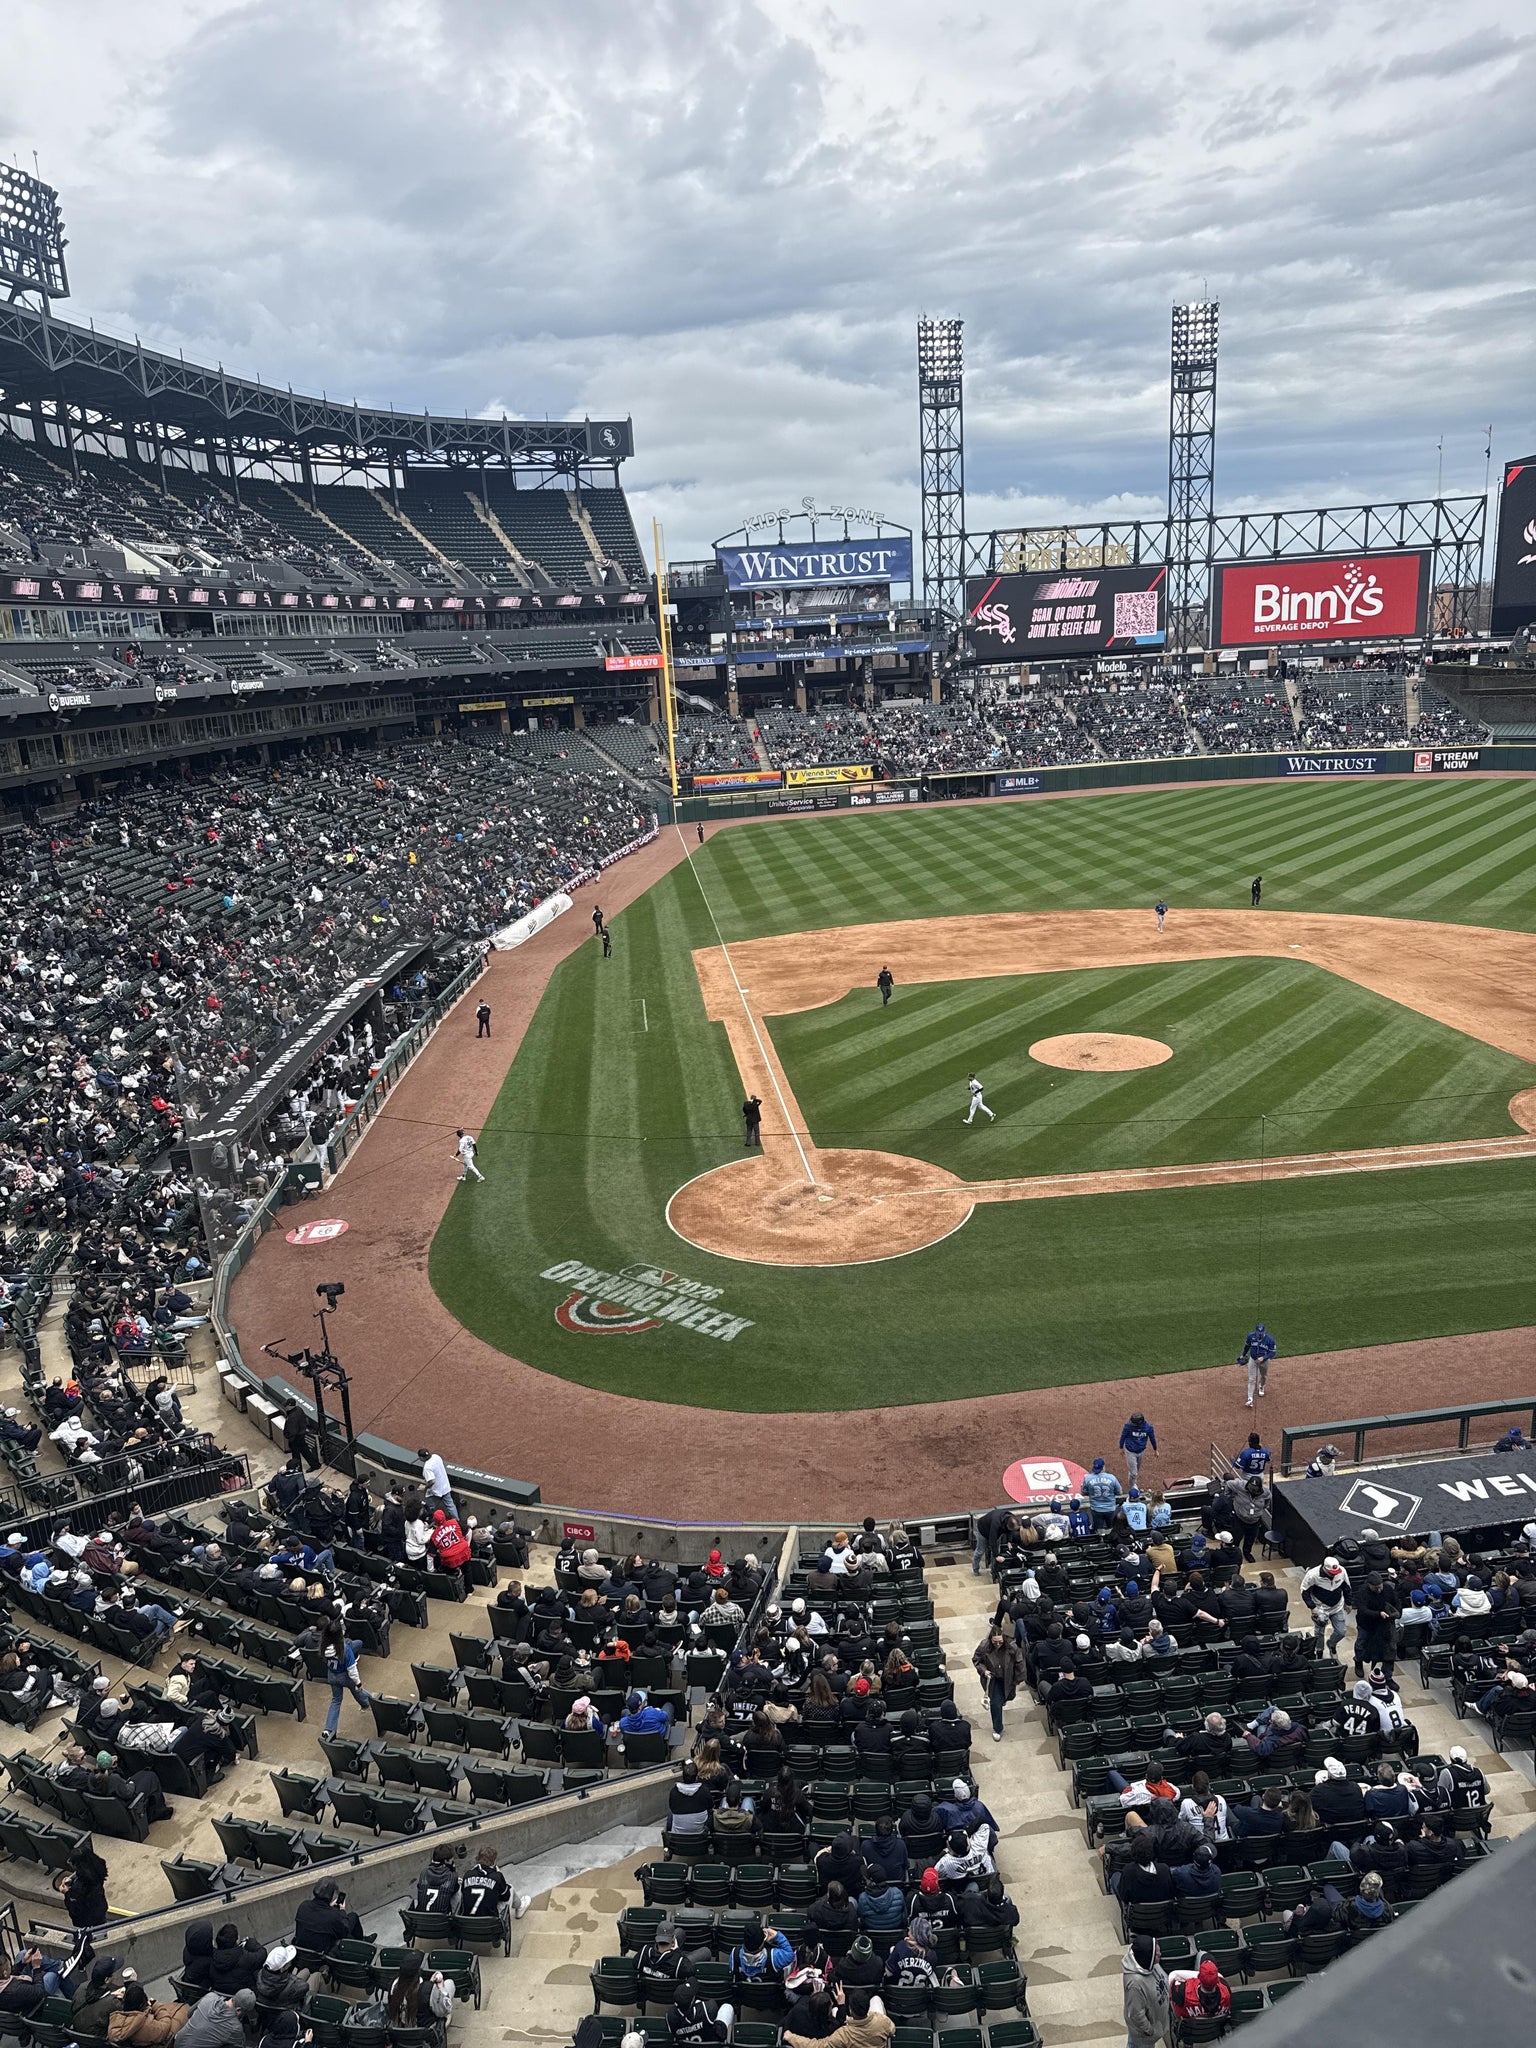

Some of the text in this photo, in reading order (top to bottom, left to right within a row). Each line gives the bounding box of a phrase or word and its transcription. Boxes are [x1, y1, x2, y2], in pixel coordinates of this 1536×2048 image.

[743, 507, 792, 533] KIDS
[830, 505, 886, 528] ZONE
[1001, 530, 1078, 547] CAESARS
[1001, 545, 1129, 573] SPORTSBOOK
[1032, 605, 1097, 622] SCAN QR CODE TO
[1028, 620, 1102, 639] JOIN THE SELFIE CAM
[1254, 621, 1331, 633] BEVERAGE DEPOT
[776, 650, 825, 660] Hometown Banking
[844, 646, 899, 656] Big-League Capabilities
[680, 657, 715, 665] WINTRUST
[1097, 660, 1127, 673] Modelo
[164, 688, 178, 698] FISK
[50, 694, 91, 707] 56 BUEHRLE
[1434, 751, 1479, 762] STREAM
[1287, 757, 1377, 771] WINTRUST
[1443, 760, 1469, 770] NOW
[801, 767, 841, 778] Vienna Beef
[1015, 777, 1040, 787] MLB+
[850, 794, 871, 806] Rate
[787, 804, 815, 812] Companies
[260, 1048, 301, 1079] CHICAGO
[217, 1105, 247, 1123] SOX
[666, 1276, 725, 1302] 2026
[539, 1259, 757, 1342] OPENING WEEK
[1249, 1459, 1265, 1470] 51
[1093, 1485, 1111, 1497] 32
[1026, 1493, 1085, 1504] TOYOTA
[1132, 1512, 1141, 1525] 4
[566, 1527, 584, 1536] CIBC
[1075, 1525, 1086, 1535] 11
[440, 1530, 461, 1548] 64
[561, 1559, 571, 1572] 12
[900, 1558, 912, 1570] 12
[1343, 1704, 1372, 1719] PEAVY
[1343, 1717, 1369, 1735] 44
[1466, 1789, 1480, 1808] 12
[463, 1877, 497, 1890] ANDERSON
[426, 1888, 439, 1912] 7
[470, 1888, 485, 1915] 7
